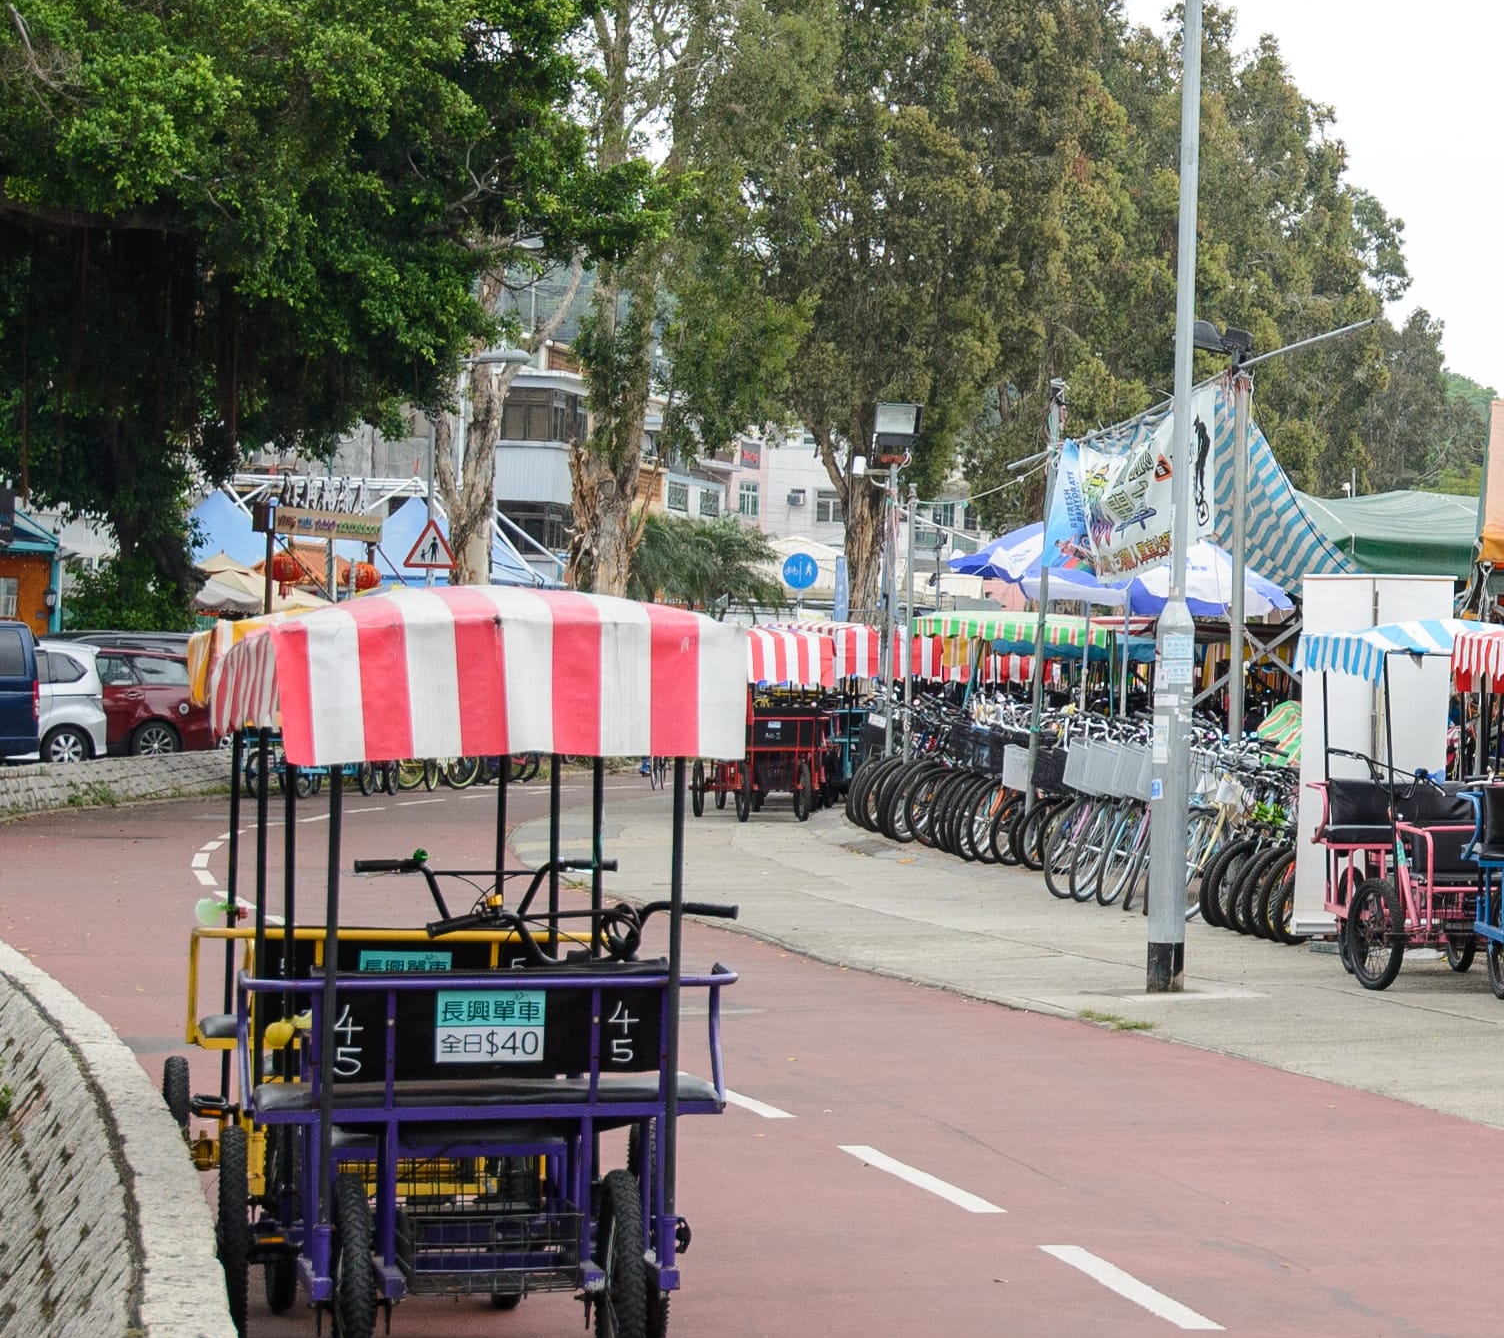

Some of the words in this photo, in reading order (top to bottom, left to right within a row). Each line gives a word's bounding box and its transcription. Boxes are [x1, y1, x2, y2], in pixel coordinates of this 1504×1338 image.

[441, 999, 542, 1023] 長興單車
[440, 1029, 540, 1058] 全日$40
